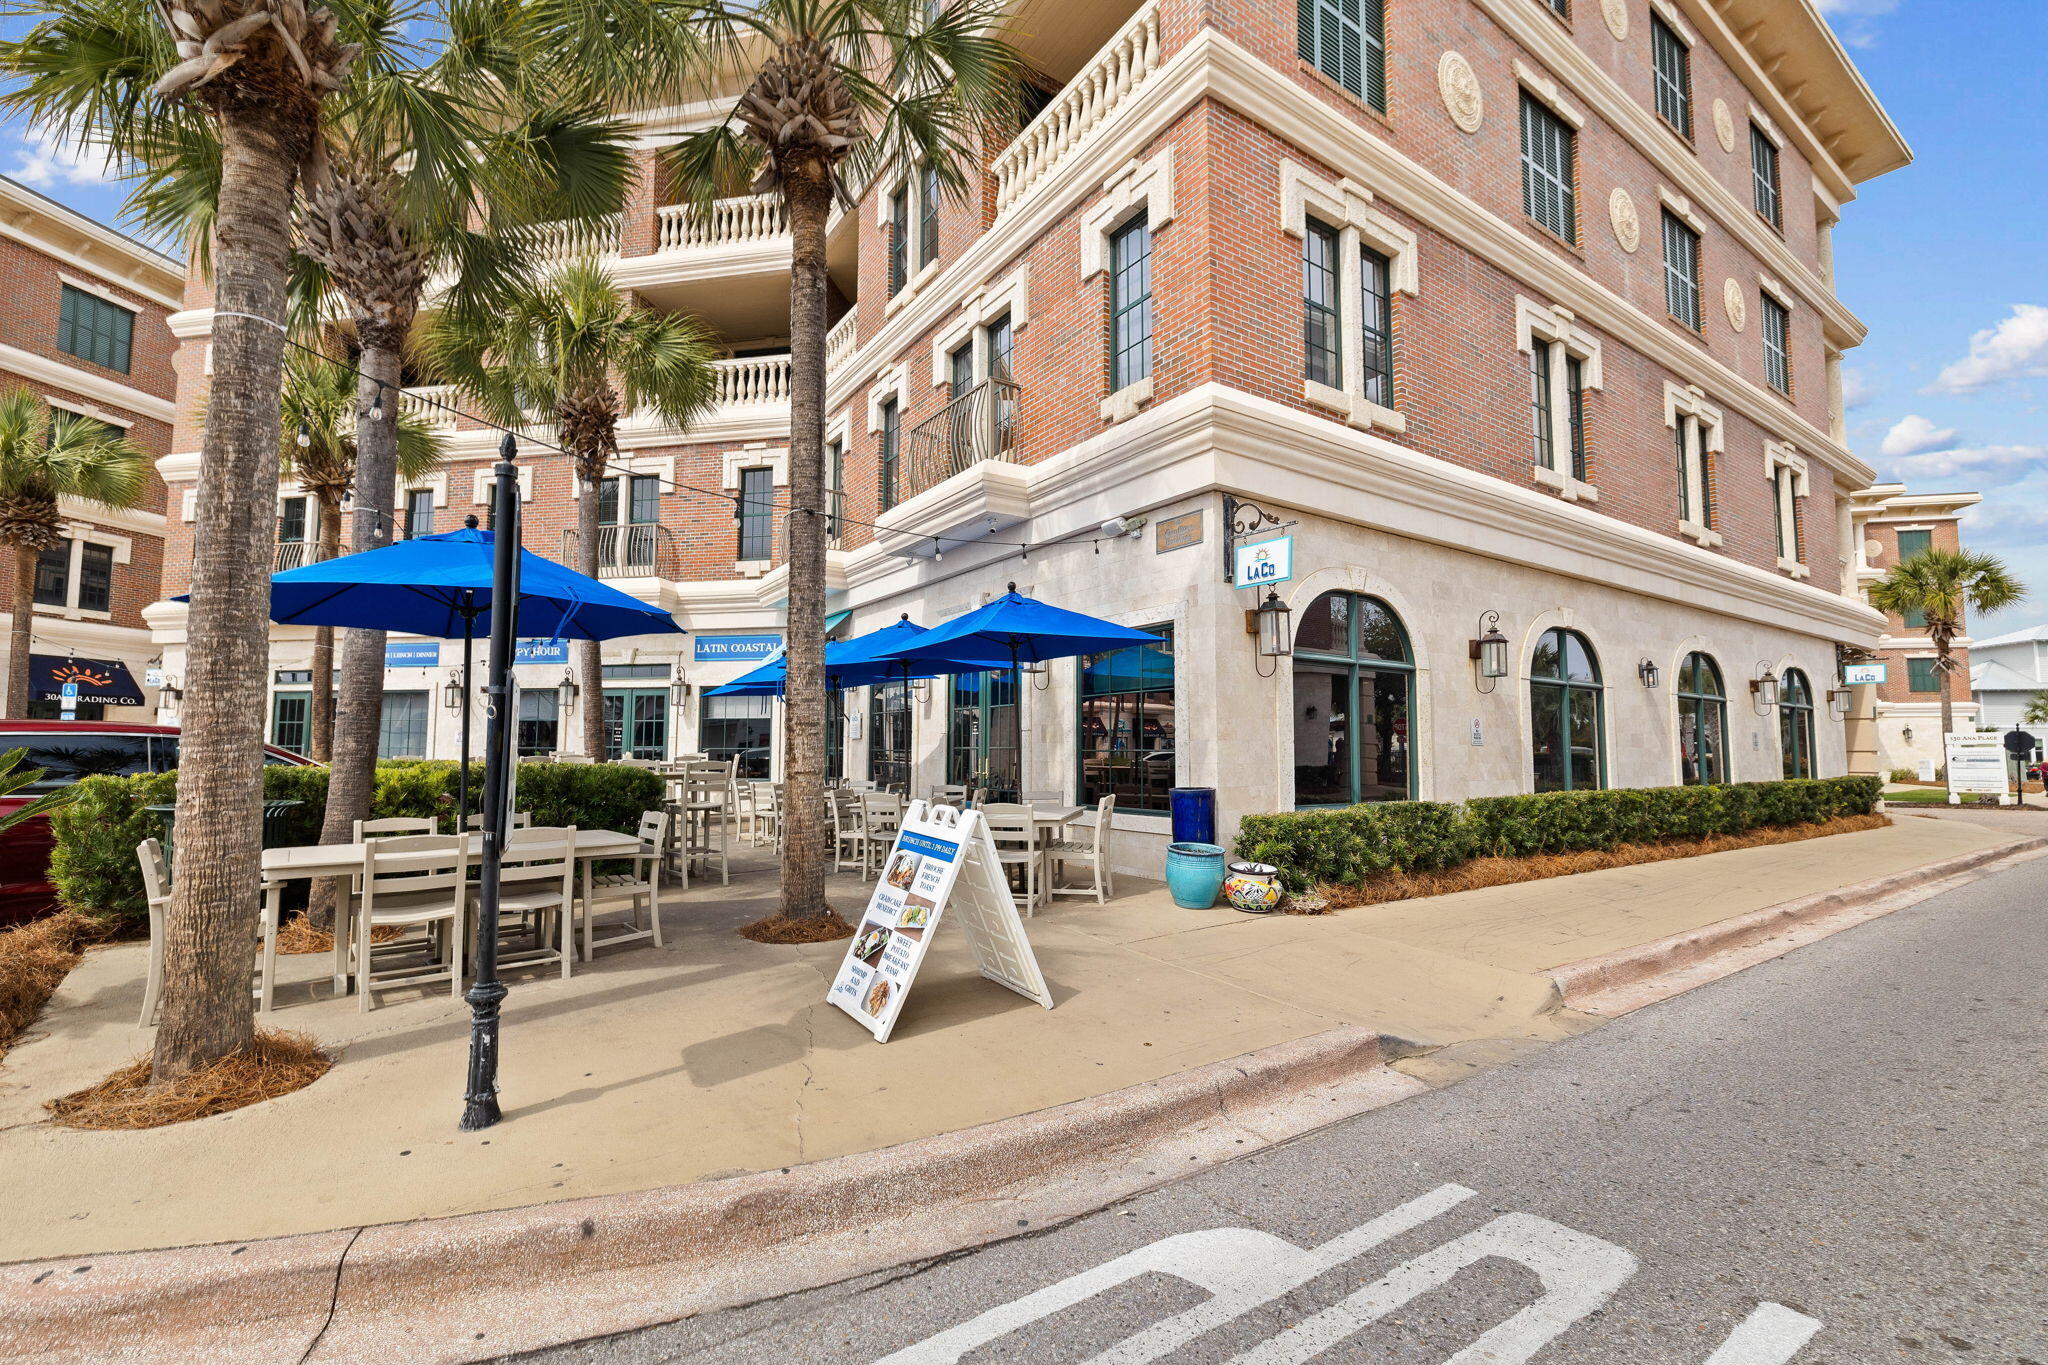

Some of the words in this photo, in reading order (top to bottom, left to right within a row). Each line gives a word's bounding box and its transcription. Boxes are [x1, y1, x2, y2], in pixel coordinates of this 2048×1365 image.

[532, 646, 561, 656] HOUR
[696, 644, 728, 653] LATIN
[44, 693, 62, 701] 30A
[77, 696, 118, 704] RADING
